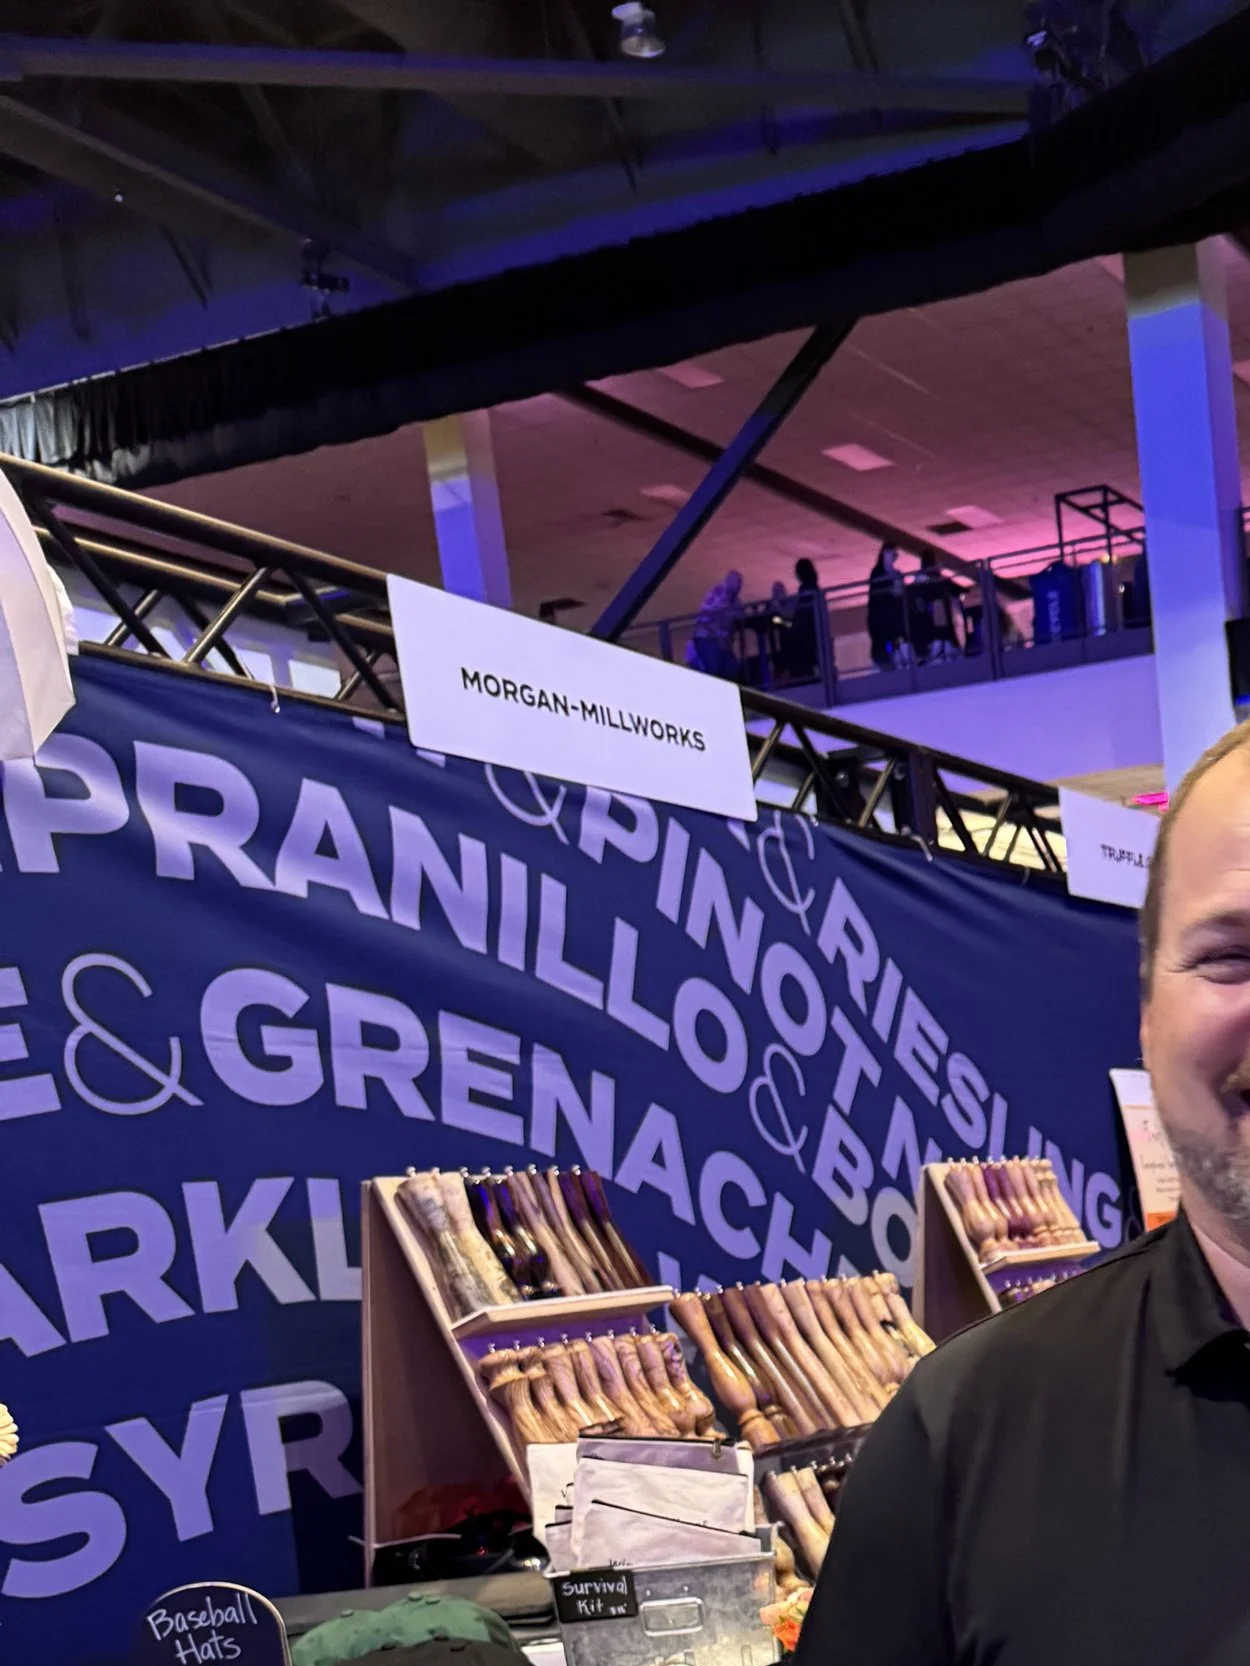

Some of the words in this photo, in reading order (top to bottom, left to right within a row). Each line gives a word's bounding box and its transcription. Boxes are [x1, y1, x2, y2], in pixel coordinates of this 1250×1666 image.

[461, 667, 706, 751] MORGAN-MILLWORKS
[577, 786, 882, 1116] PINOT
[61, 953, 204, 1116] &
[200, 967, 862, 1286] GRENACH
[748, 1043, 808, 1175] &
[147, 1592, 258, 1641] Baseball
[562, 1575, 628, 1597] Survival
[577, 1597, 604, 1615] Kit
[176, 1629, 242, 1665] Hats
